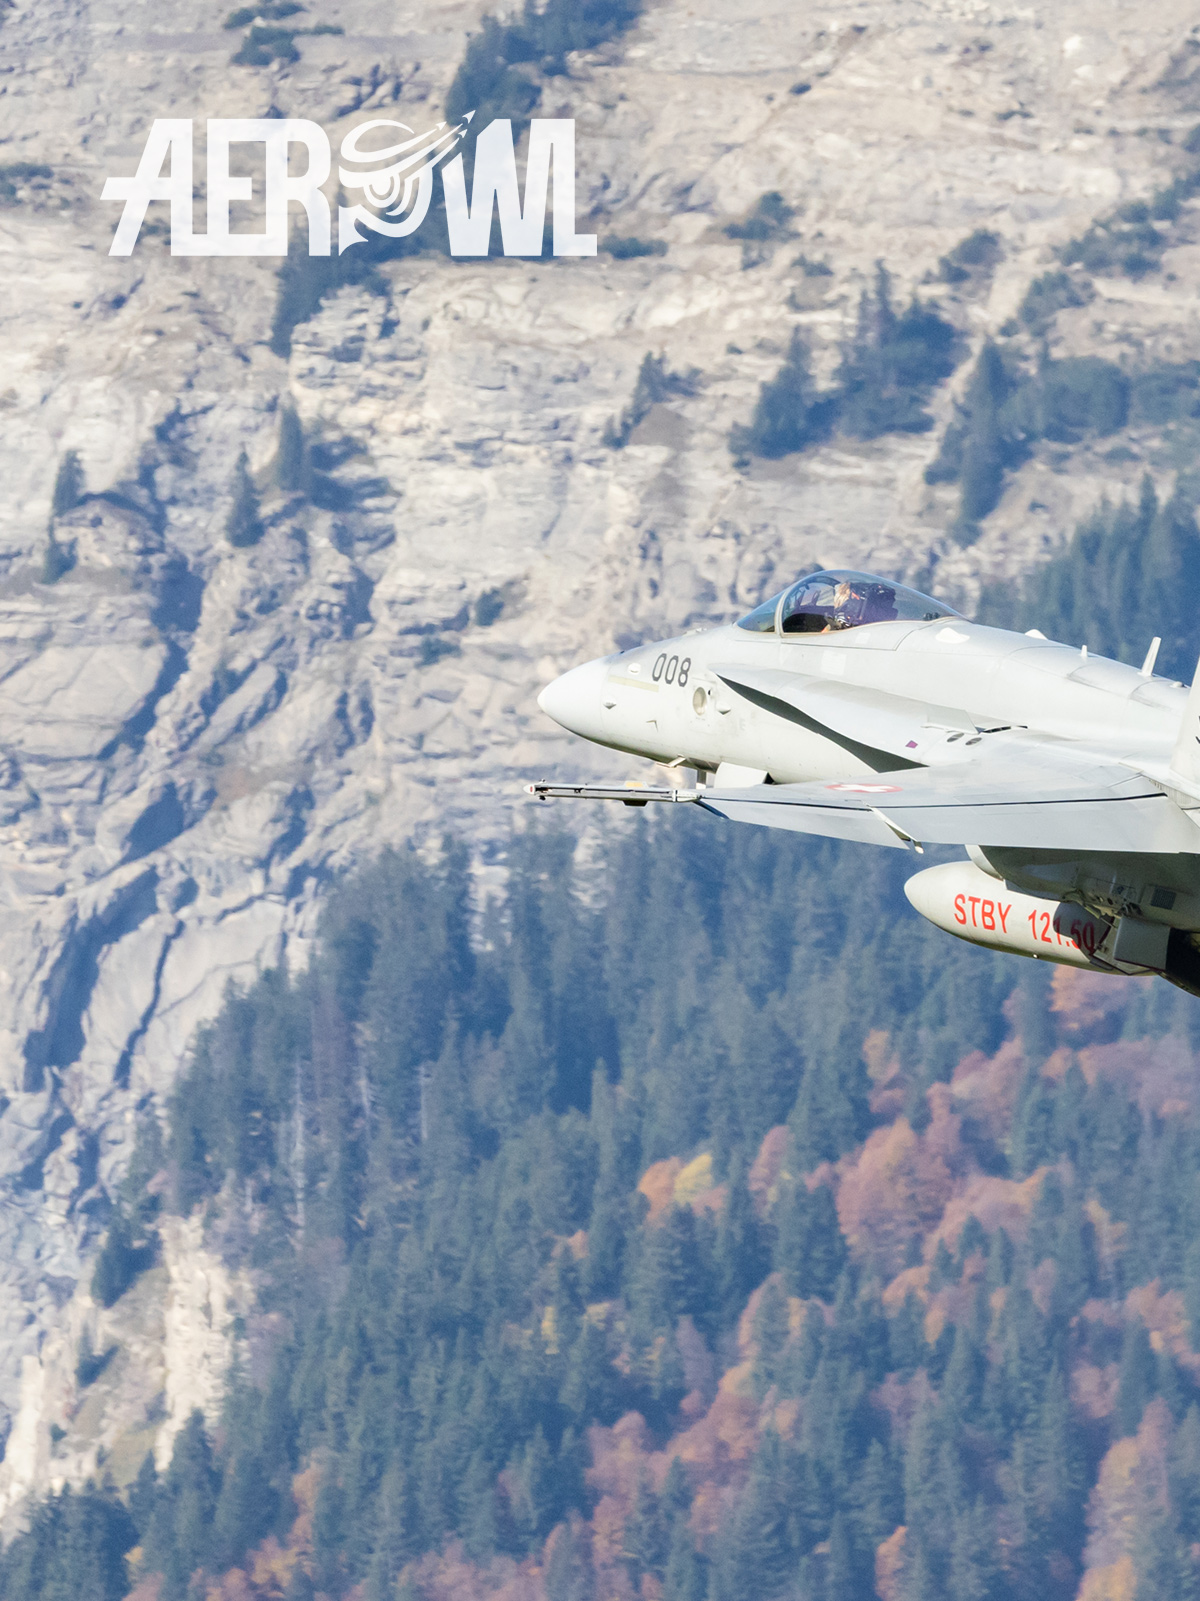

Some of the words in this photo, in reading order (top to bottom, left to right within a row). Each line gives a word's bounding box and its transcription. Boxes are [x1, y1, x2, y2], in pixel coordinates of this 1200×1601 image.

[651, 652, 692, 688] 008
[954, 893, 1012, 934] STBY
[1027, 909, 1096, 952] 121.50
